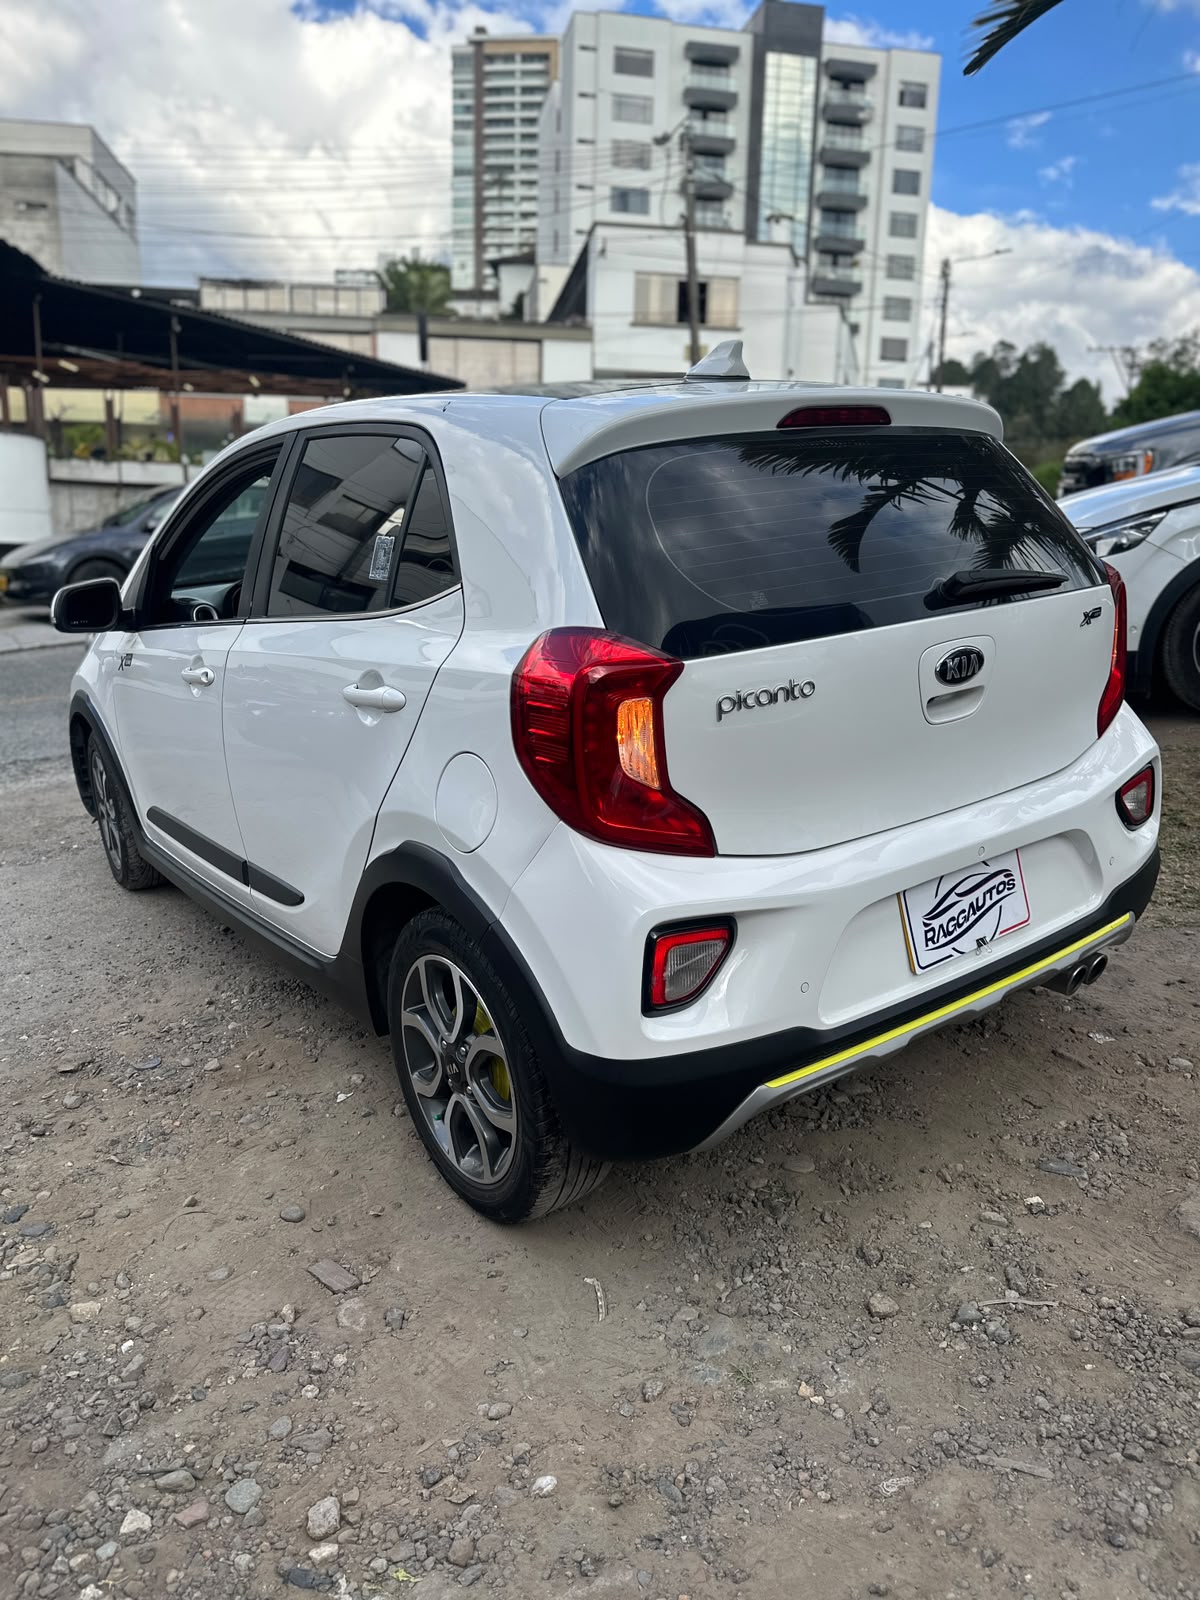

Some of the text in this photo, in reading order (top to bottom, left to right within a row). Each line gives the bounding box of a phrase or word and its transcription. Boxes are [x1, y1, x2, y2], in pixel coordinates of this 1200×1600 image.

[946, 653, 979, 680] KIA
[716, 679, 816, 722] picanto
[923, 878, 1016, 948] RAGGAUTOS
